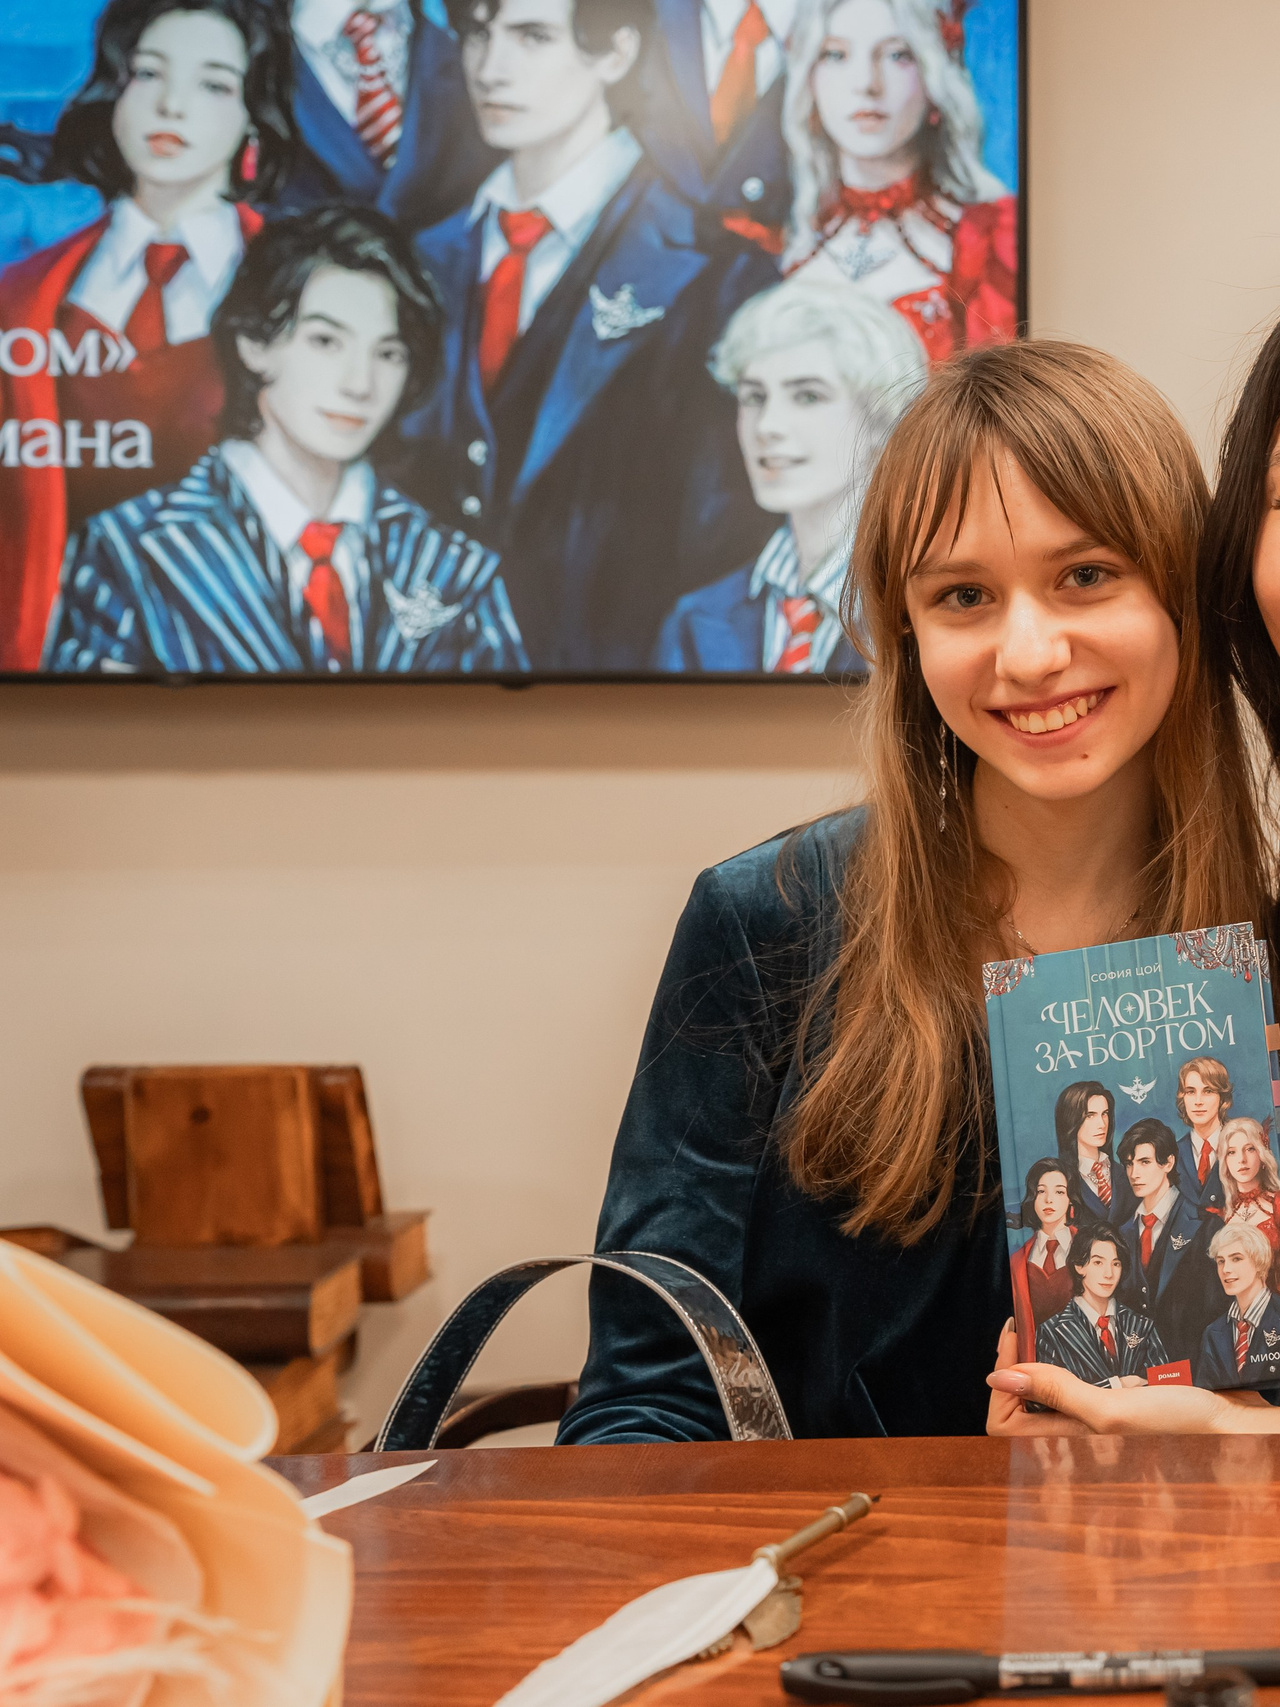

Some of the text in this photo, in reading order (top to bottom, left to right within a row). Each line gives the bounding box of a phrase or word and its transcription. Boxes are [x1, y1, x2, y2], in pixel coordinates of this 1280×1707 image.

[0, 327, 137, 377] ом»
[1090, 962, 1161, 983] СОФИЯ ЦОЙ
[1040, 980, 1214, 1035] ЧЕЛОВЕК
[1034, 1014, 1236, 1074] ЗА БОРТОМ
[1157, 1371, 1181, 1381] роман
